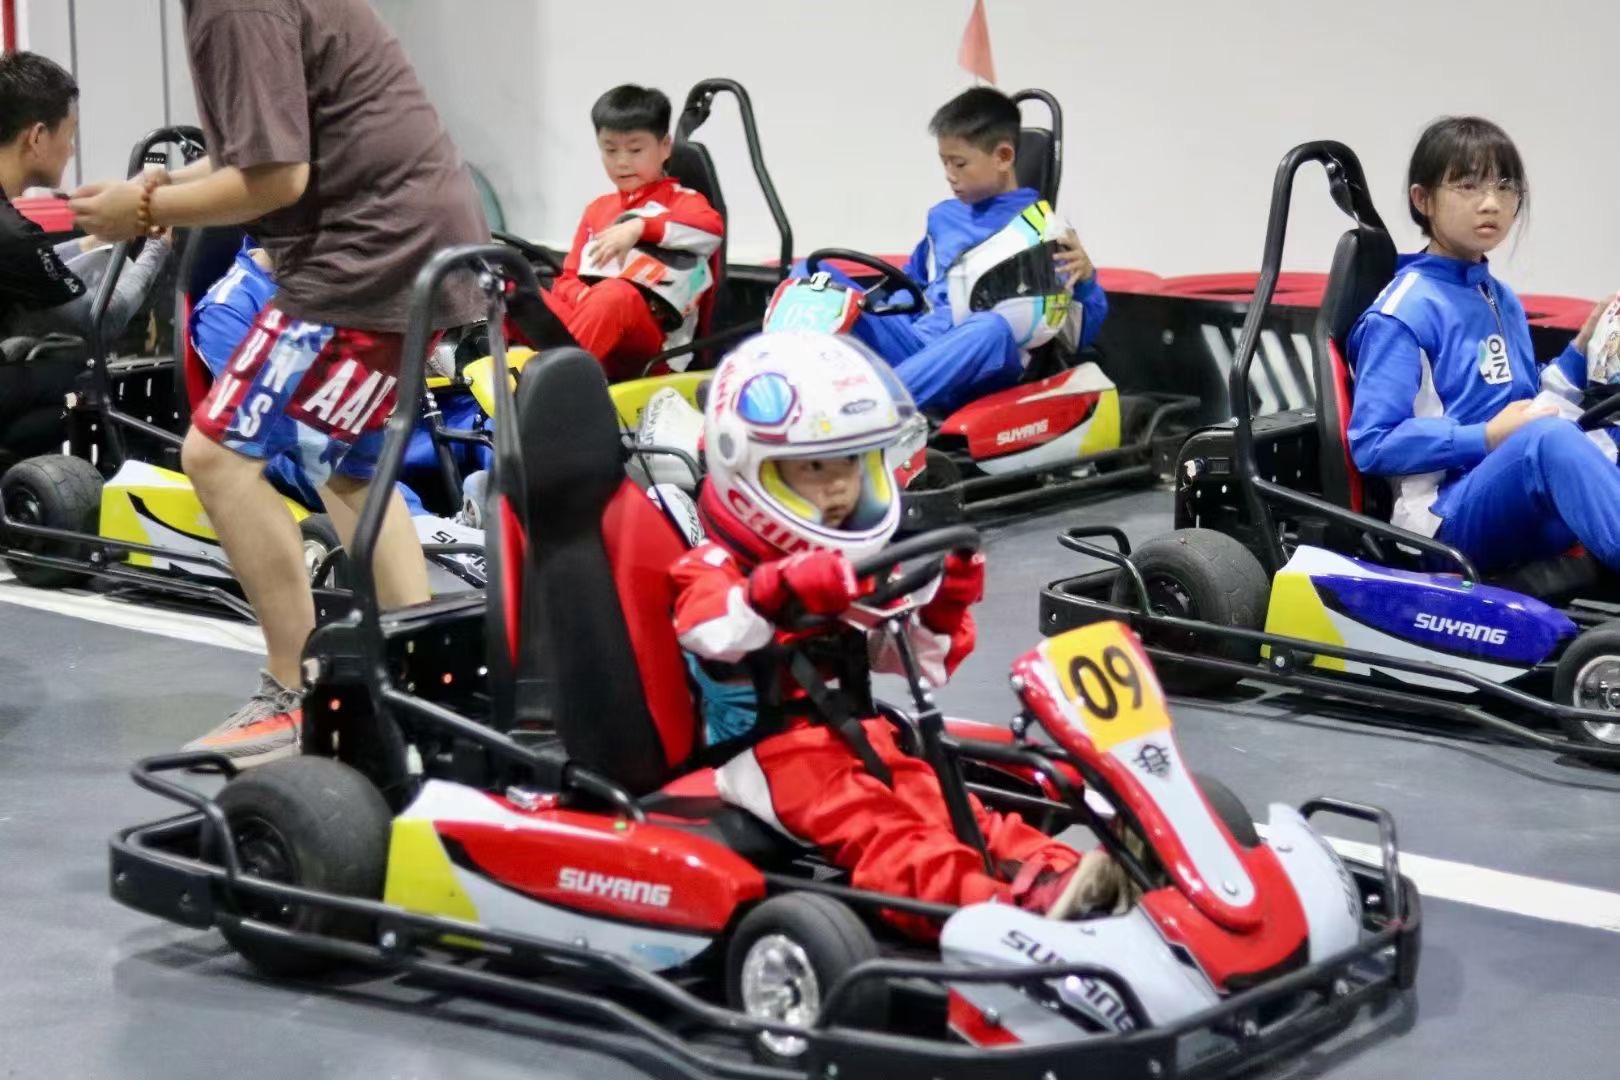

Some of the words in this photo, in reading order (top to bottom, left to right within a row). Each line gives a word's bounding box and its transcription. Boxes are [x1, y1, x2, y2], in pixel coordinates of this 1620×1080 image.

[996, 418, 1049, 446] SUYANG
[1413, 612, 1509, 645] SUYANG
[1069, 645, 1143, 720] 09
[558, 866, 673, 907] SUYANG
